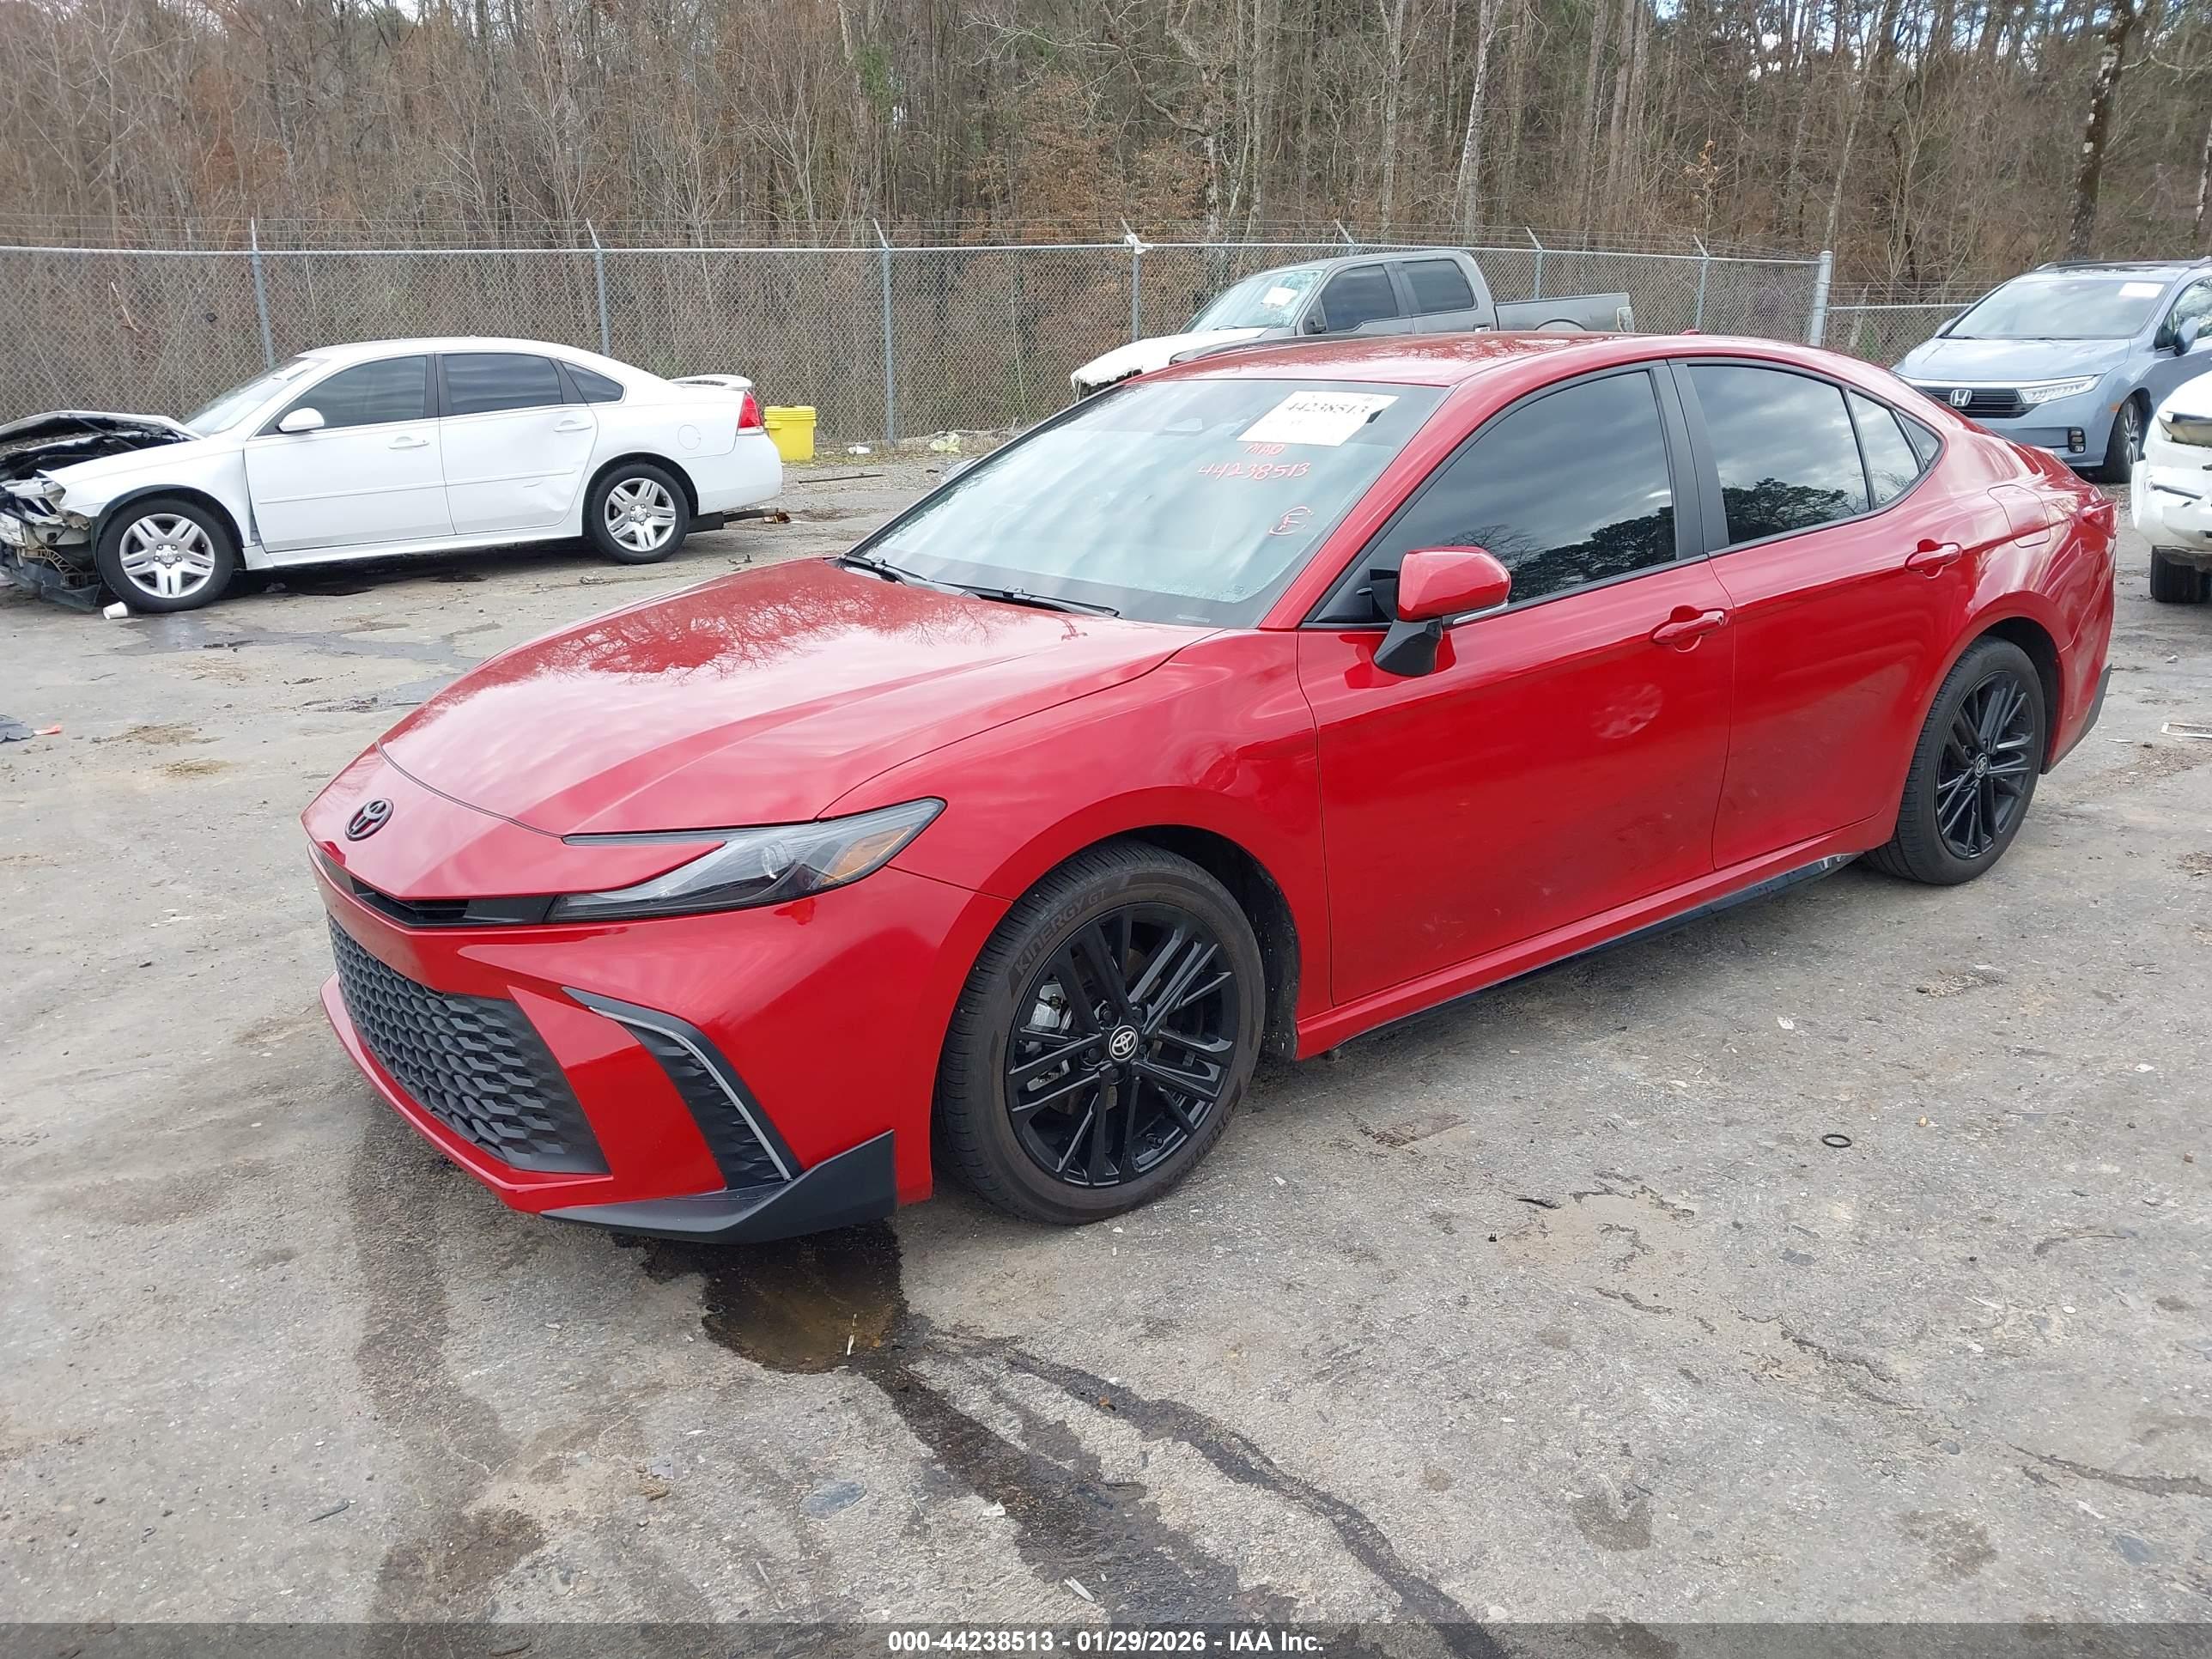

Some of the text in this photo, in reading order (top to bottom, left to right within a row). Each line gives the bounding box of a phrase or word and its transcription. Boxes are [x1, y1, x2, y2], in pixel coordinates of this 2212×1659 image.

[1197, 462, 1312, 482] 44238513
[1014, 887, 1108, 976] KINERGY GT
